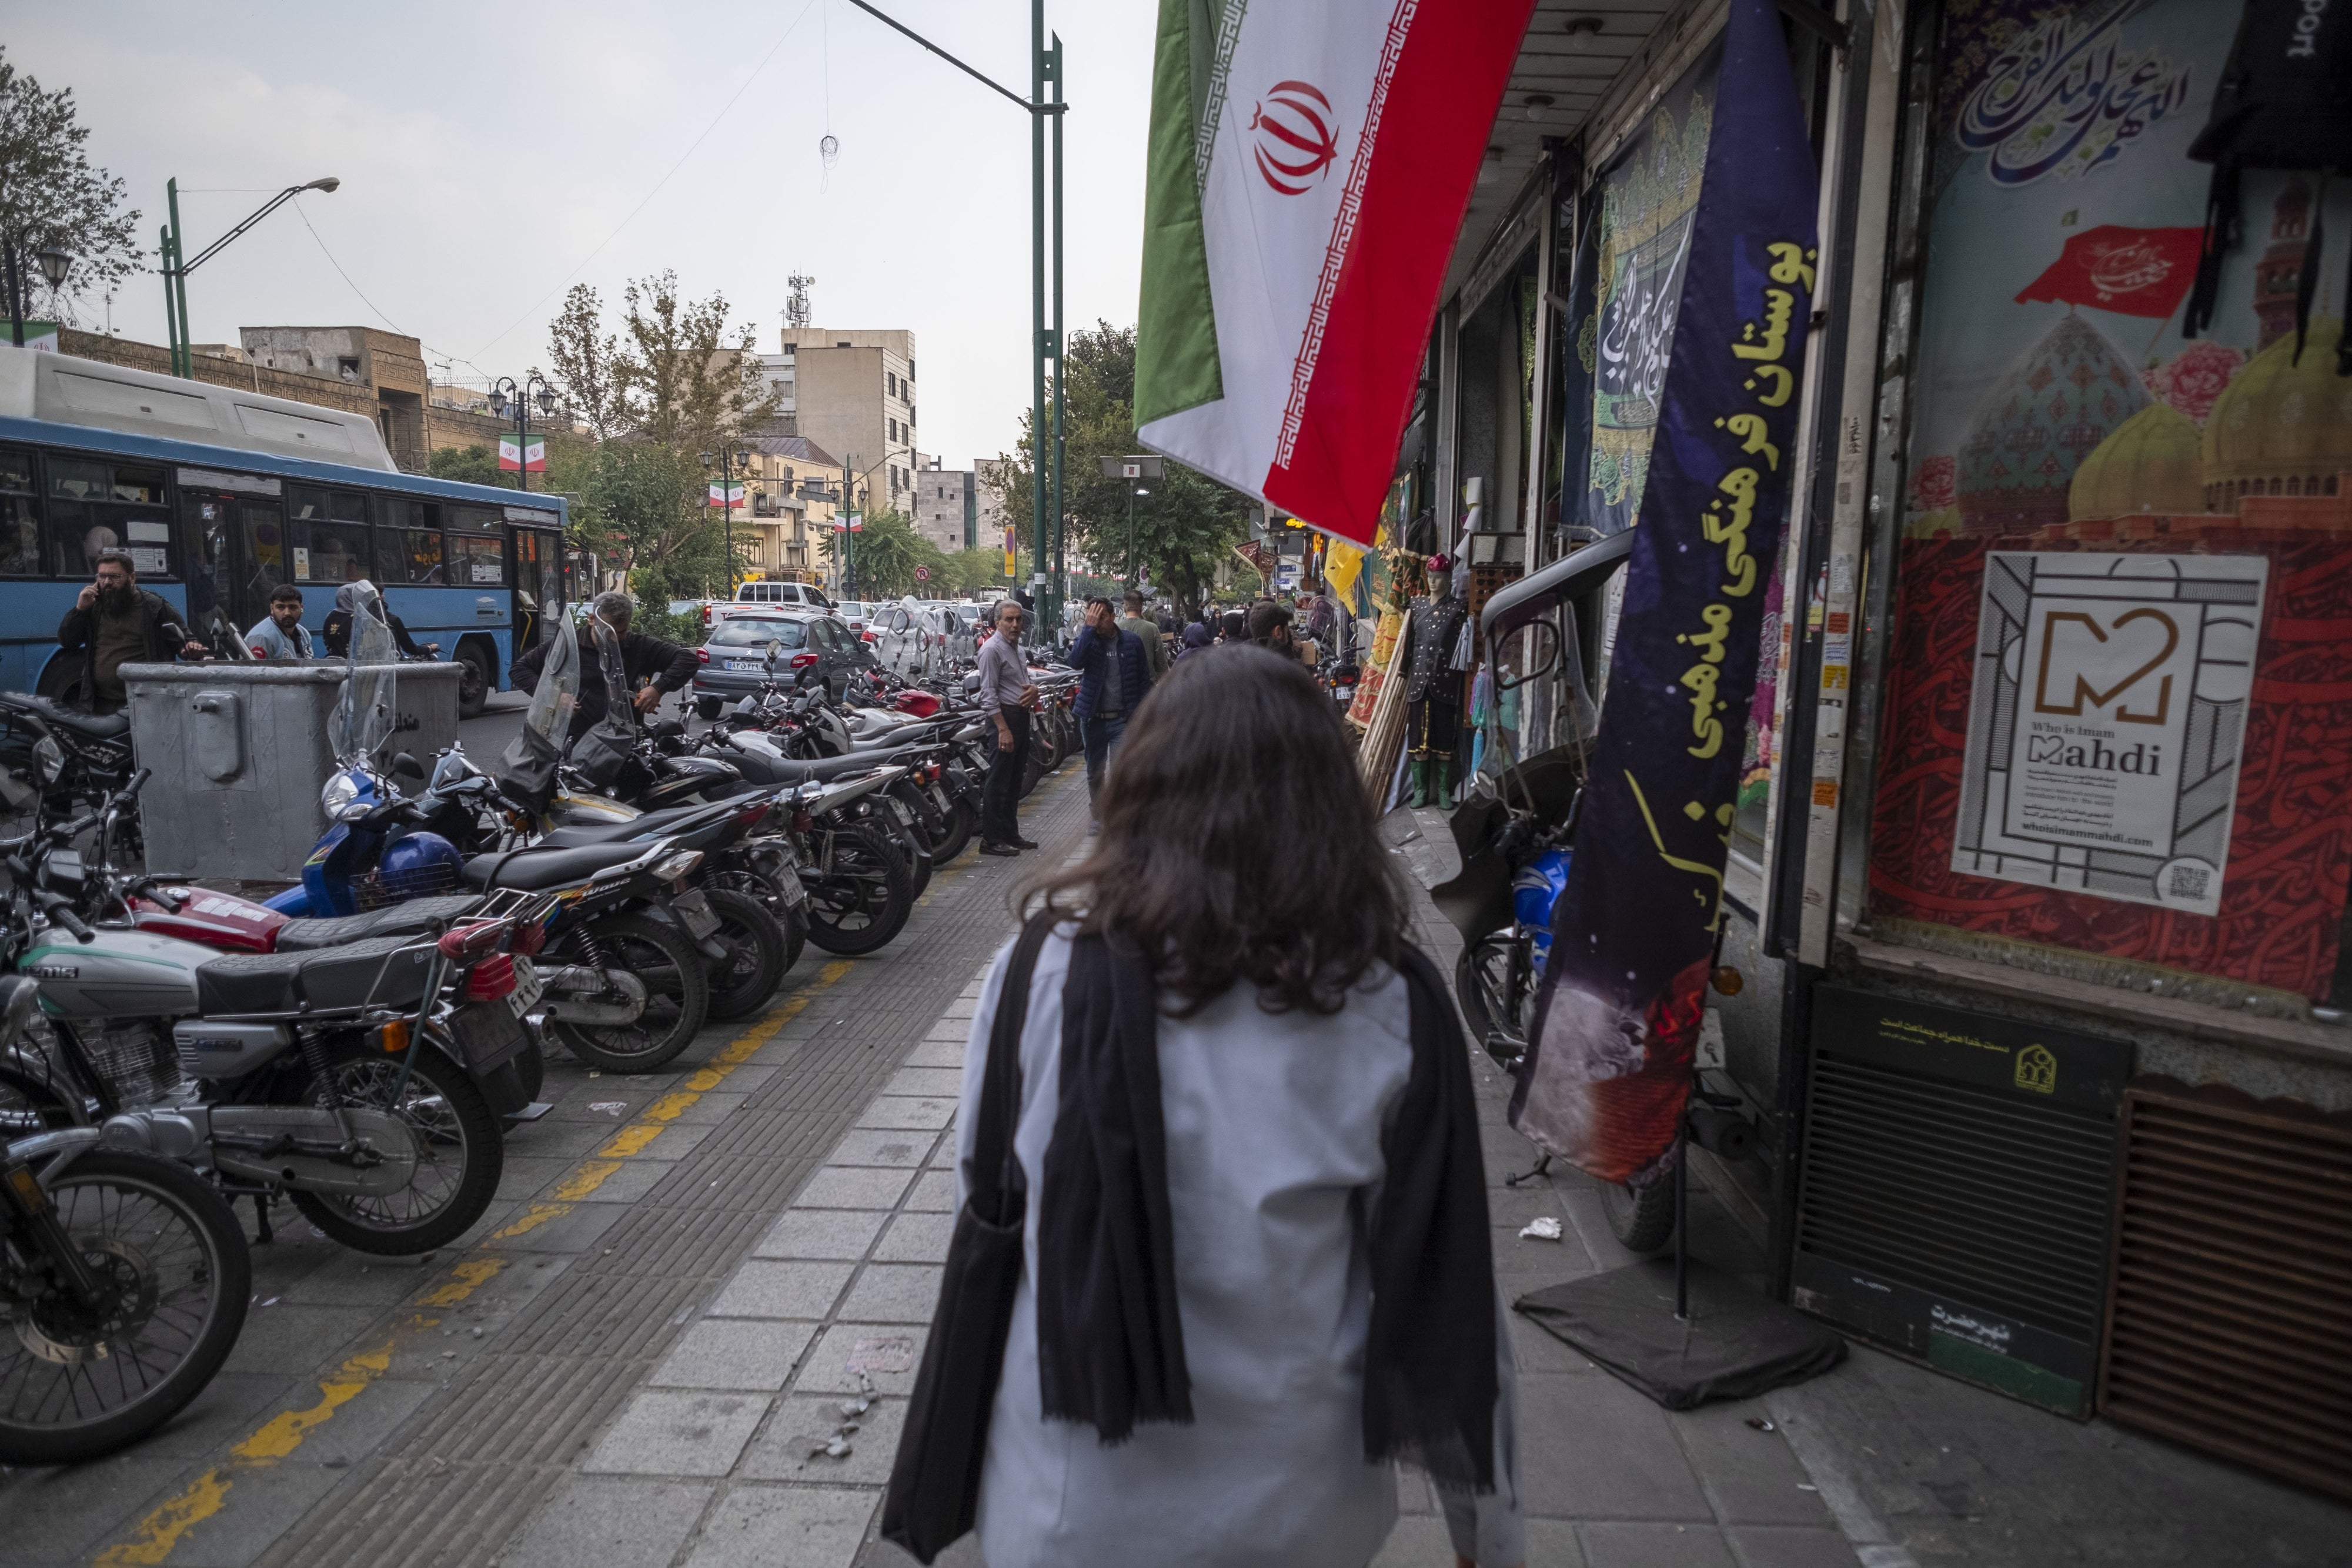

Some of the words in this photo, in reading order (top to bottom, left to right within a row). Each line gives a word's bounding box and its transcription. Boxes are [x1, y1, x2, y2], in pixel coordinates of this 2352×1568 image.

[1731, 242, 1818, 407] بوستان
[1702, 413, 1780, 597] فرهنگی
[1675, 604, 1733, 759] مذهبی
[2032, 722, 2062, 733] Who
[2064, 724, 2074, 734] is
[2077, 726, 2114, 738] Imam
[2027, 734, 2161, 776] Mahdi
[2022, 821, 2153, 847] whoisimammahdi.com
